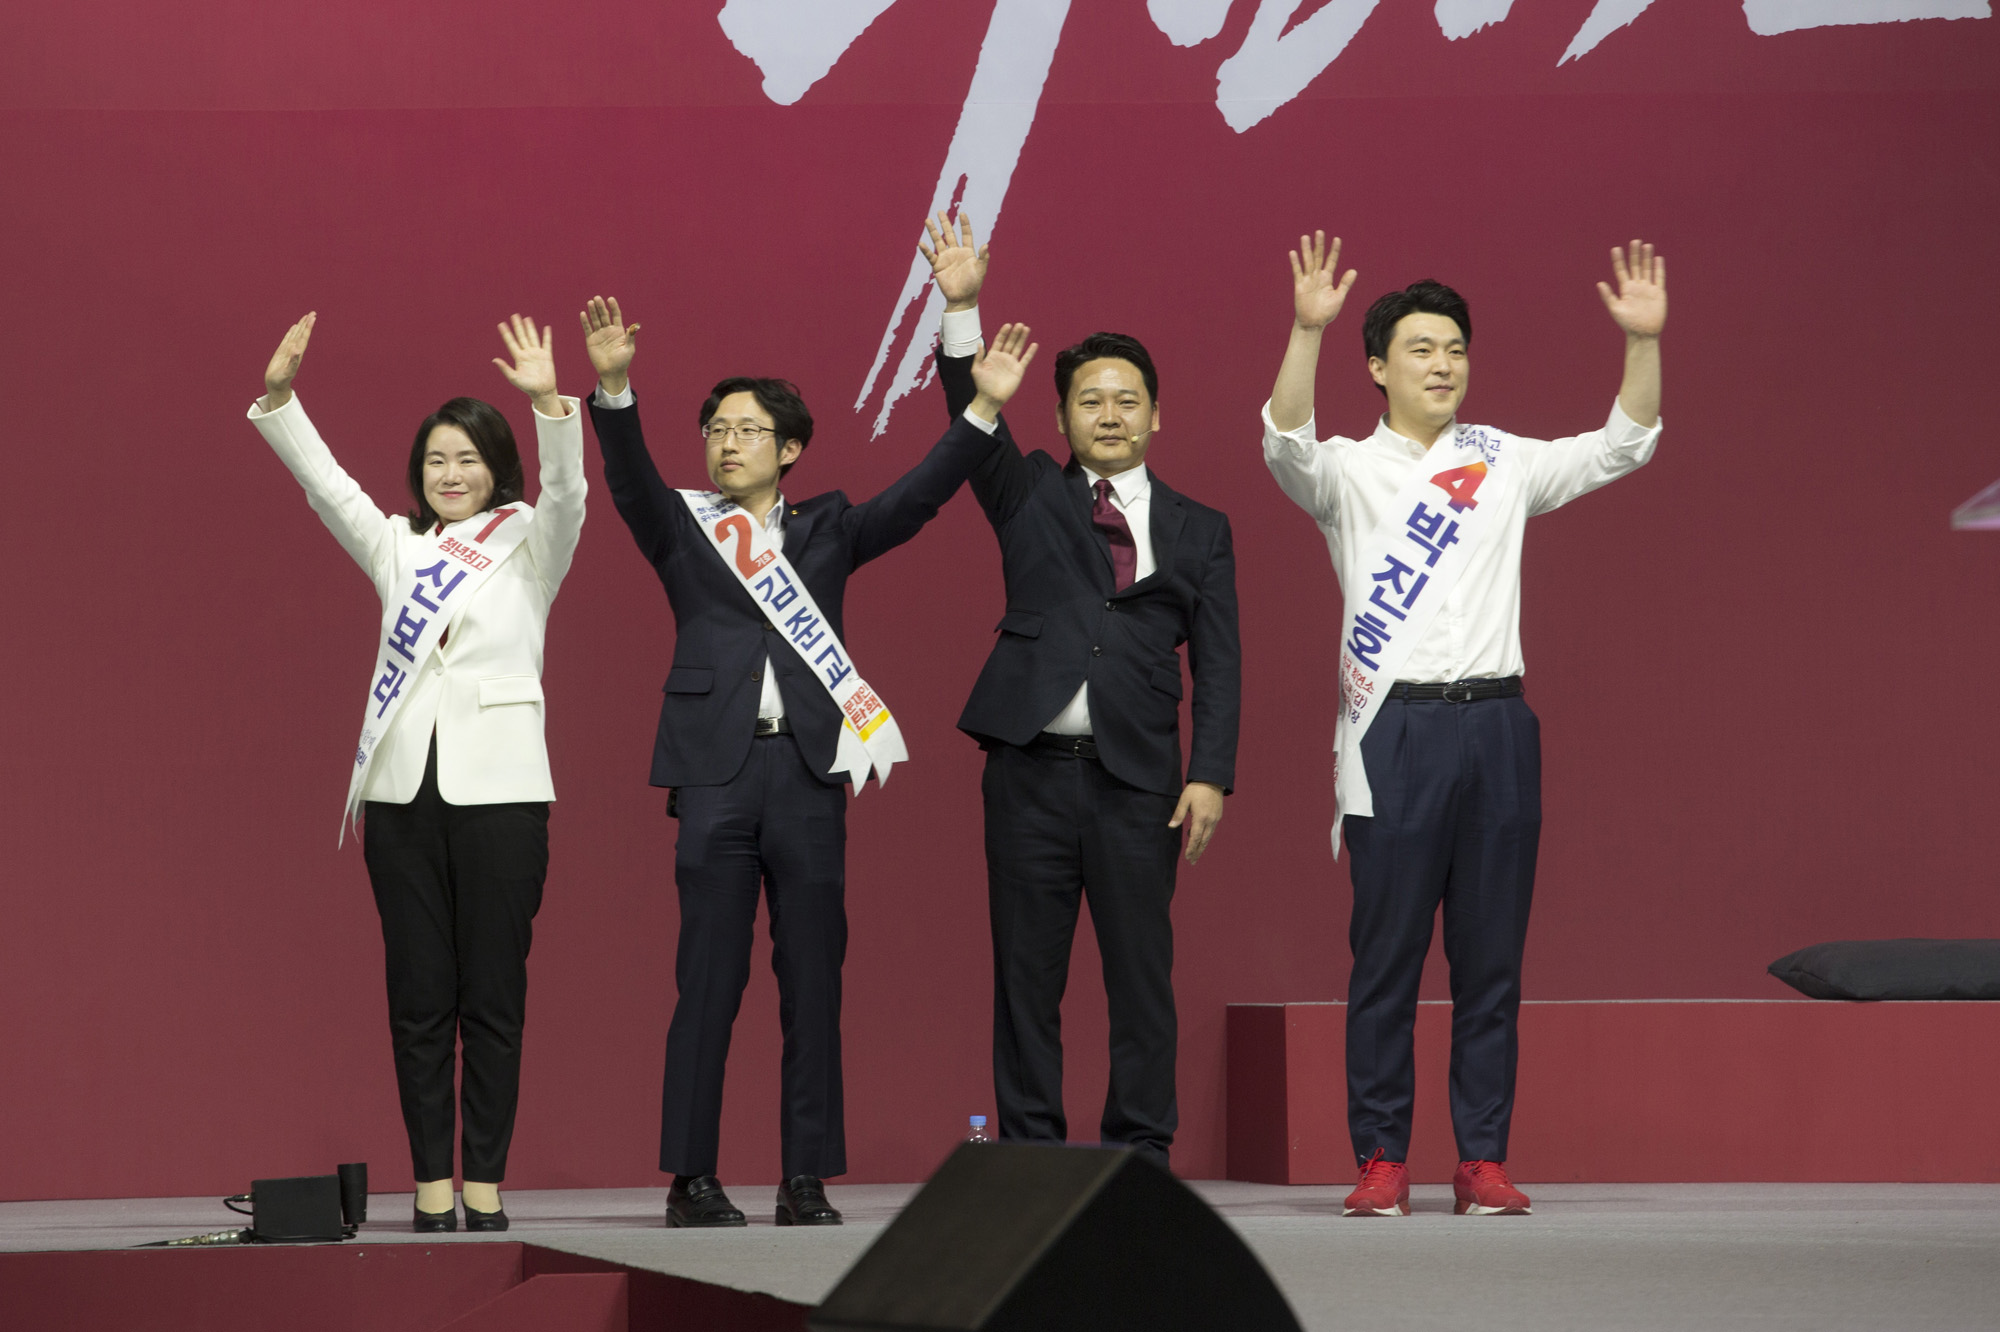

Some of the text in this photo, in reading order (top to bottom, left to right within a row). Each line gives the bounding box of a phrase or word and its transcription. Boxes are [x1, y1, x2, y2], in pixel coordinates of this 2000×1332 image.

[1429, 461, 1488, 514] 4
[473, 508, 520, 544] 1
[714, 514, 776, 580] 2
[438, 537, 493, 571] 청년최고
[1347, 501, 1460, 671] 박진호
[373, 559, 468, 719] 신보라
[755, 566, 851, 691] 김준교
[843, 683, 872, 716] 문재인
[850, 694, 882, 731] 탄핵
